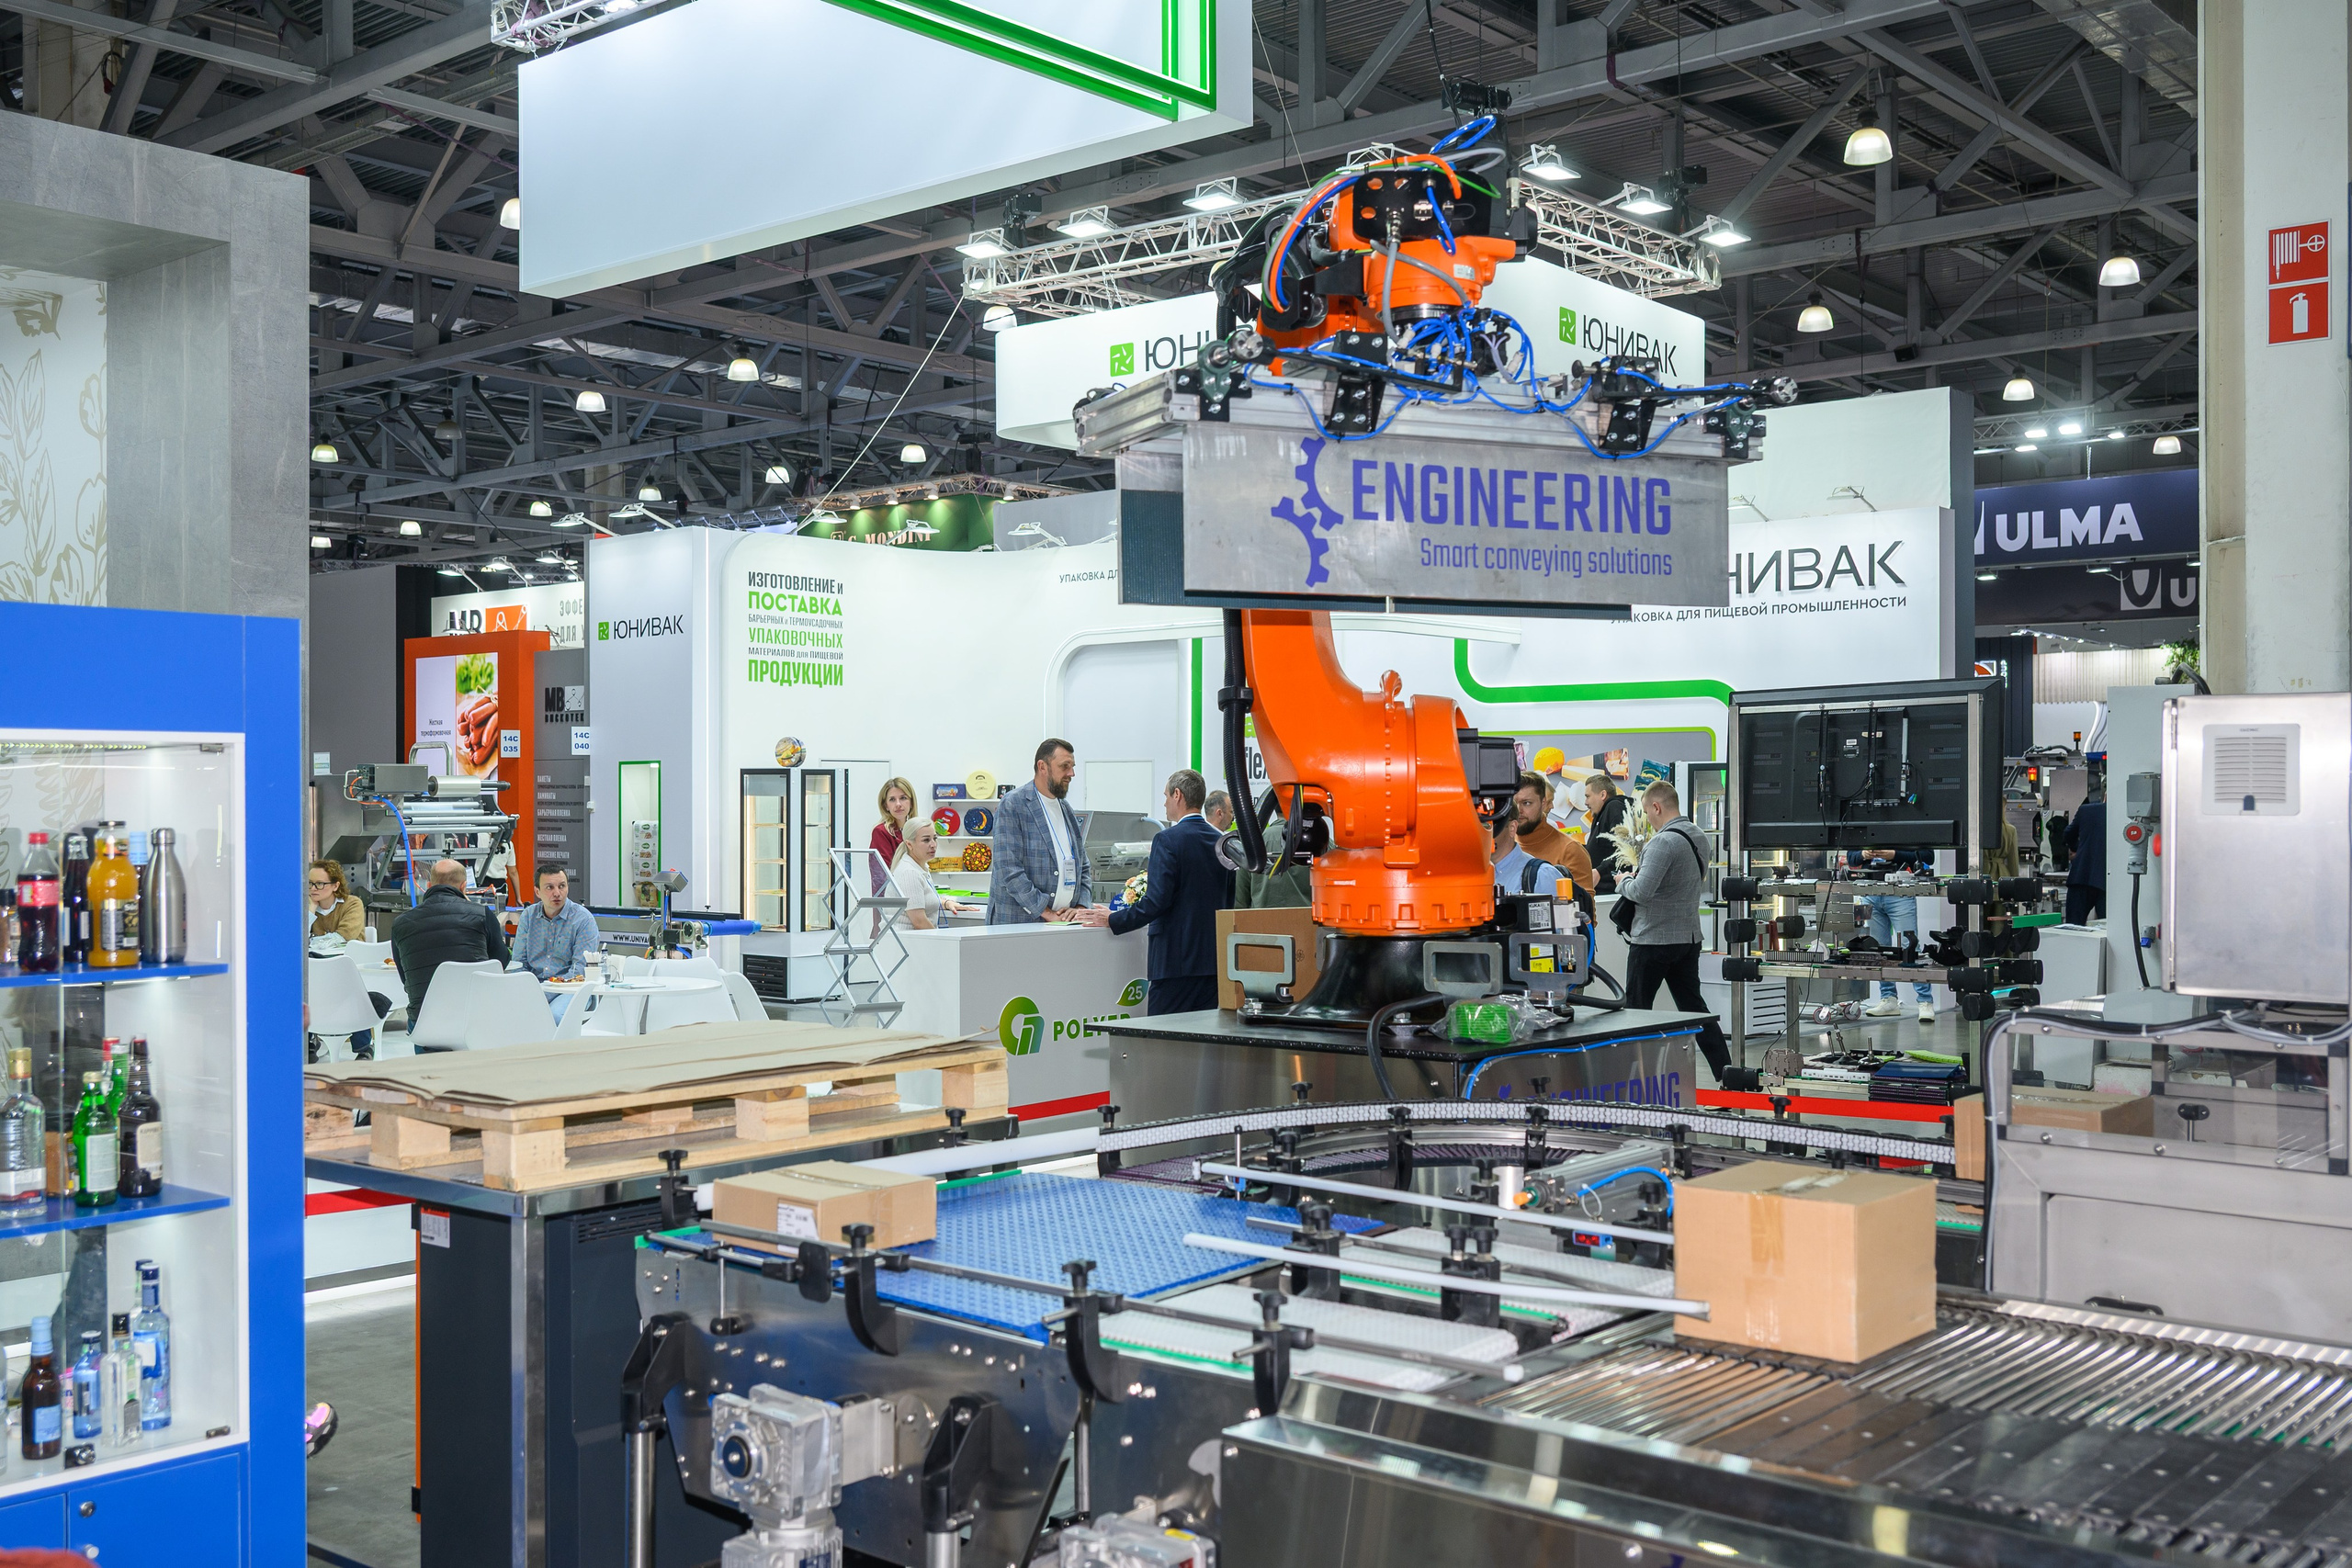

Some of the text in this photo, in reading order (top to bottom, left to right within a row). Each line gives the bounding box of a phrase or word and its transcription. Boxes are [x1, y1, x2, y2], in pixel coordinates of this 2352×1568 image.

[1583, 314, 1677, 378] ЮНИВАК
[1351, 459, 1672, 536] ENGINEERING
[1996, 502, 2144, 552] ULMA
[1420, 538, 1673, 579] Smart conveying solutions
[1728, 540, 1906, 595] НИВАК
[748, 571, 843, 594] ИЗГОТОВЛЕНИЕ и
[1059, 569, 1119, 583] УПАКОВКА ДЛ
[748, 591, 843, 616] ПОСТАВКА
[1611, 595, 1907, 624] КОВКА ДЛЯ ПИЩЕВОЙ ПРОМЫШЛЕННОСТИ
[613, 615, 684, 639] ЮНИВАК
[748, 613, 785, 625] БАРЬЕРНЫХ
[789, 616, 843, 629] ТЕРМОУСАДОЧНЫХ
[749, 627, 843, 649] УПАКОВОЧНЫХ
[748, 647, 843, 660] МАТЕРИАЛОВ для ПИЩЕВОЙ
[748, 660, 843, 688] ПРОДУКЦИИ
[613, 934, 649, 943] WWW.UNIVA
[1127, 986, 1143, 1000] 25
